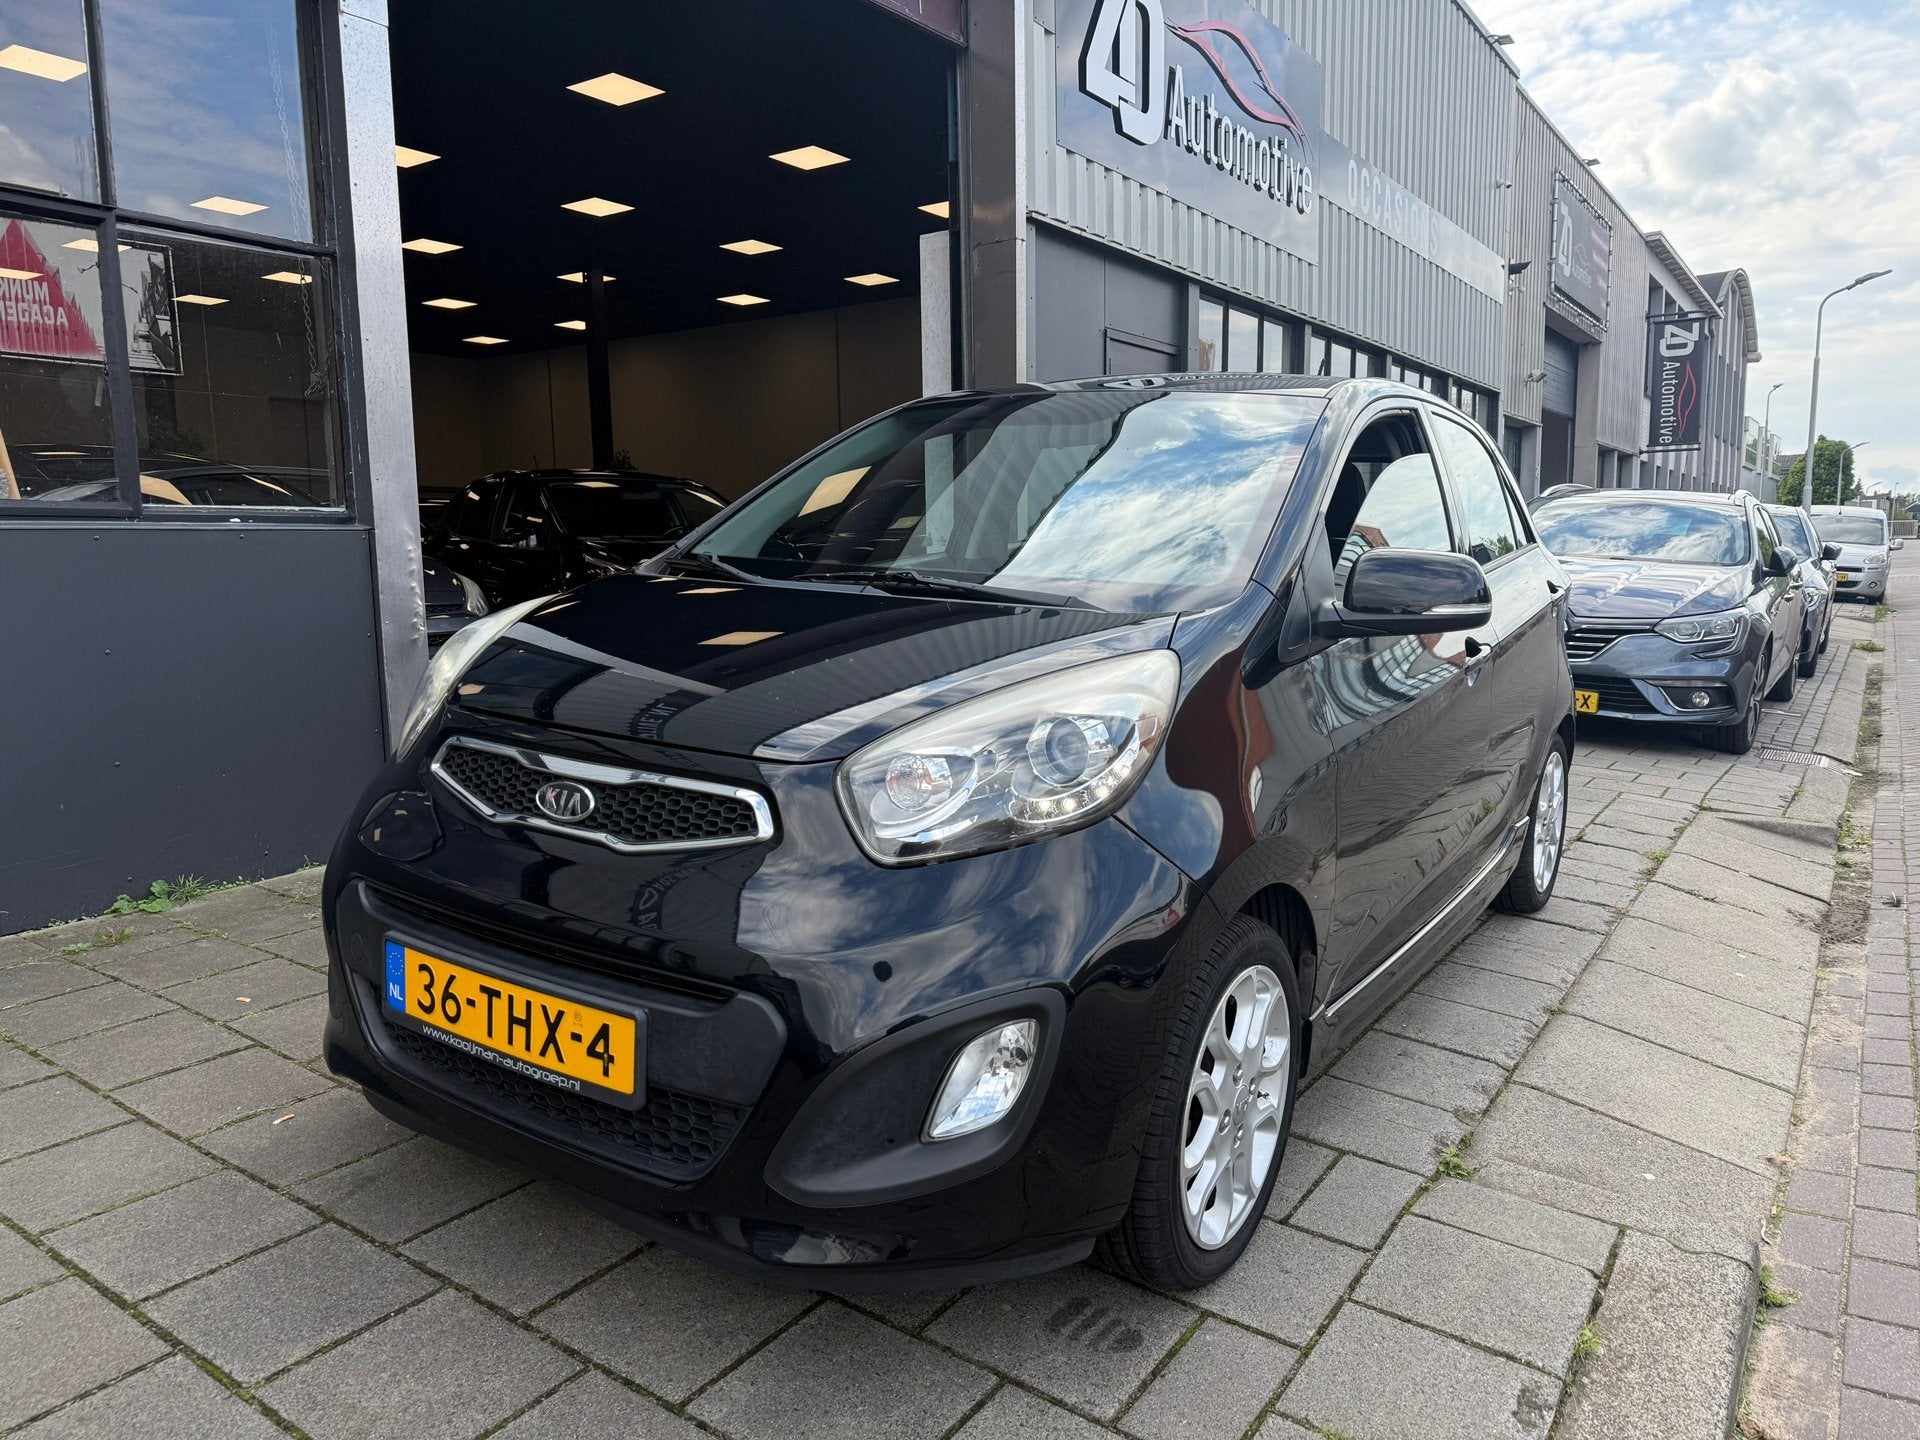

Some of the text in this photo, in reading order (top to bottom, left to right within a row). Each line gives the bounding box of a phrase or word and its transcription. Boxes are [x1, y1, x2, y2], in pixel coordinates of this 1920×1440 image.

[1167, 63, 1312, 214] Automotive
[1347, 158, 1439, 257] OCCASIONS
[1659, 361, 1681, 444] Automotive
[543, 786, 581, 816] KIA
[389, 963, 615, 1078] NL 36-THX-4
[422, 1024, 581, 1091] www.kooijman-autogroep.nl
